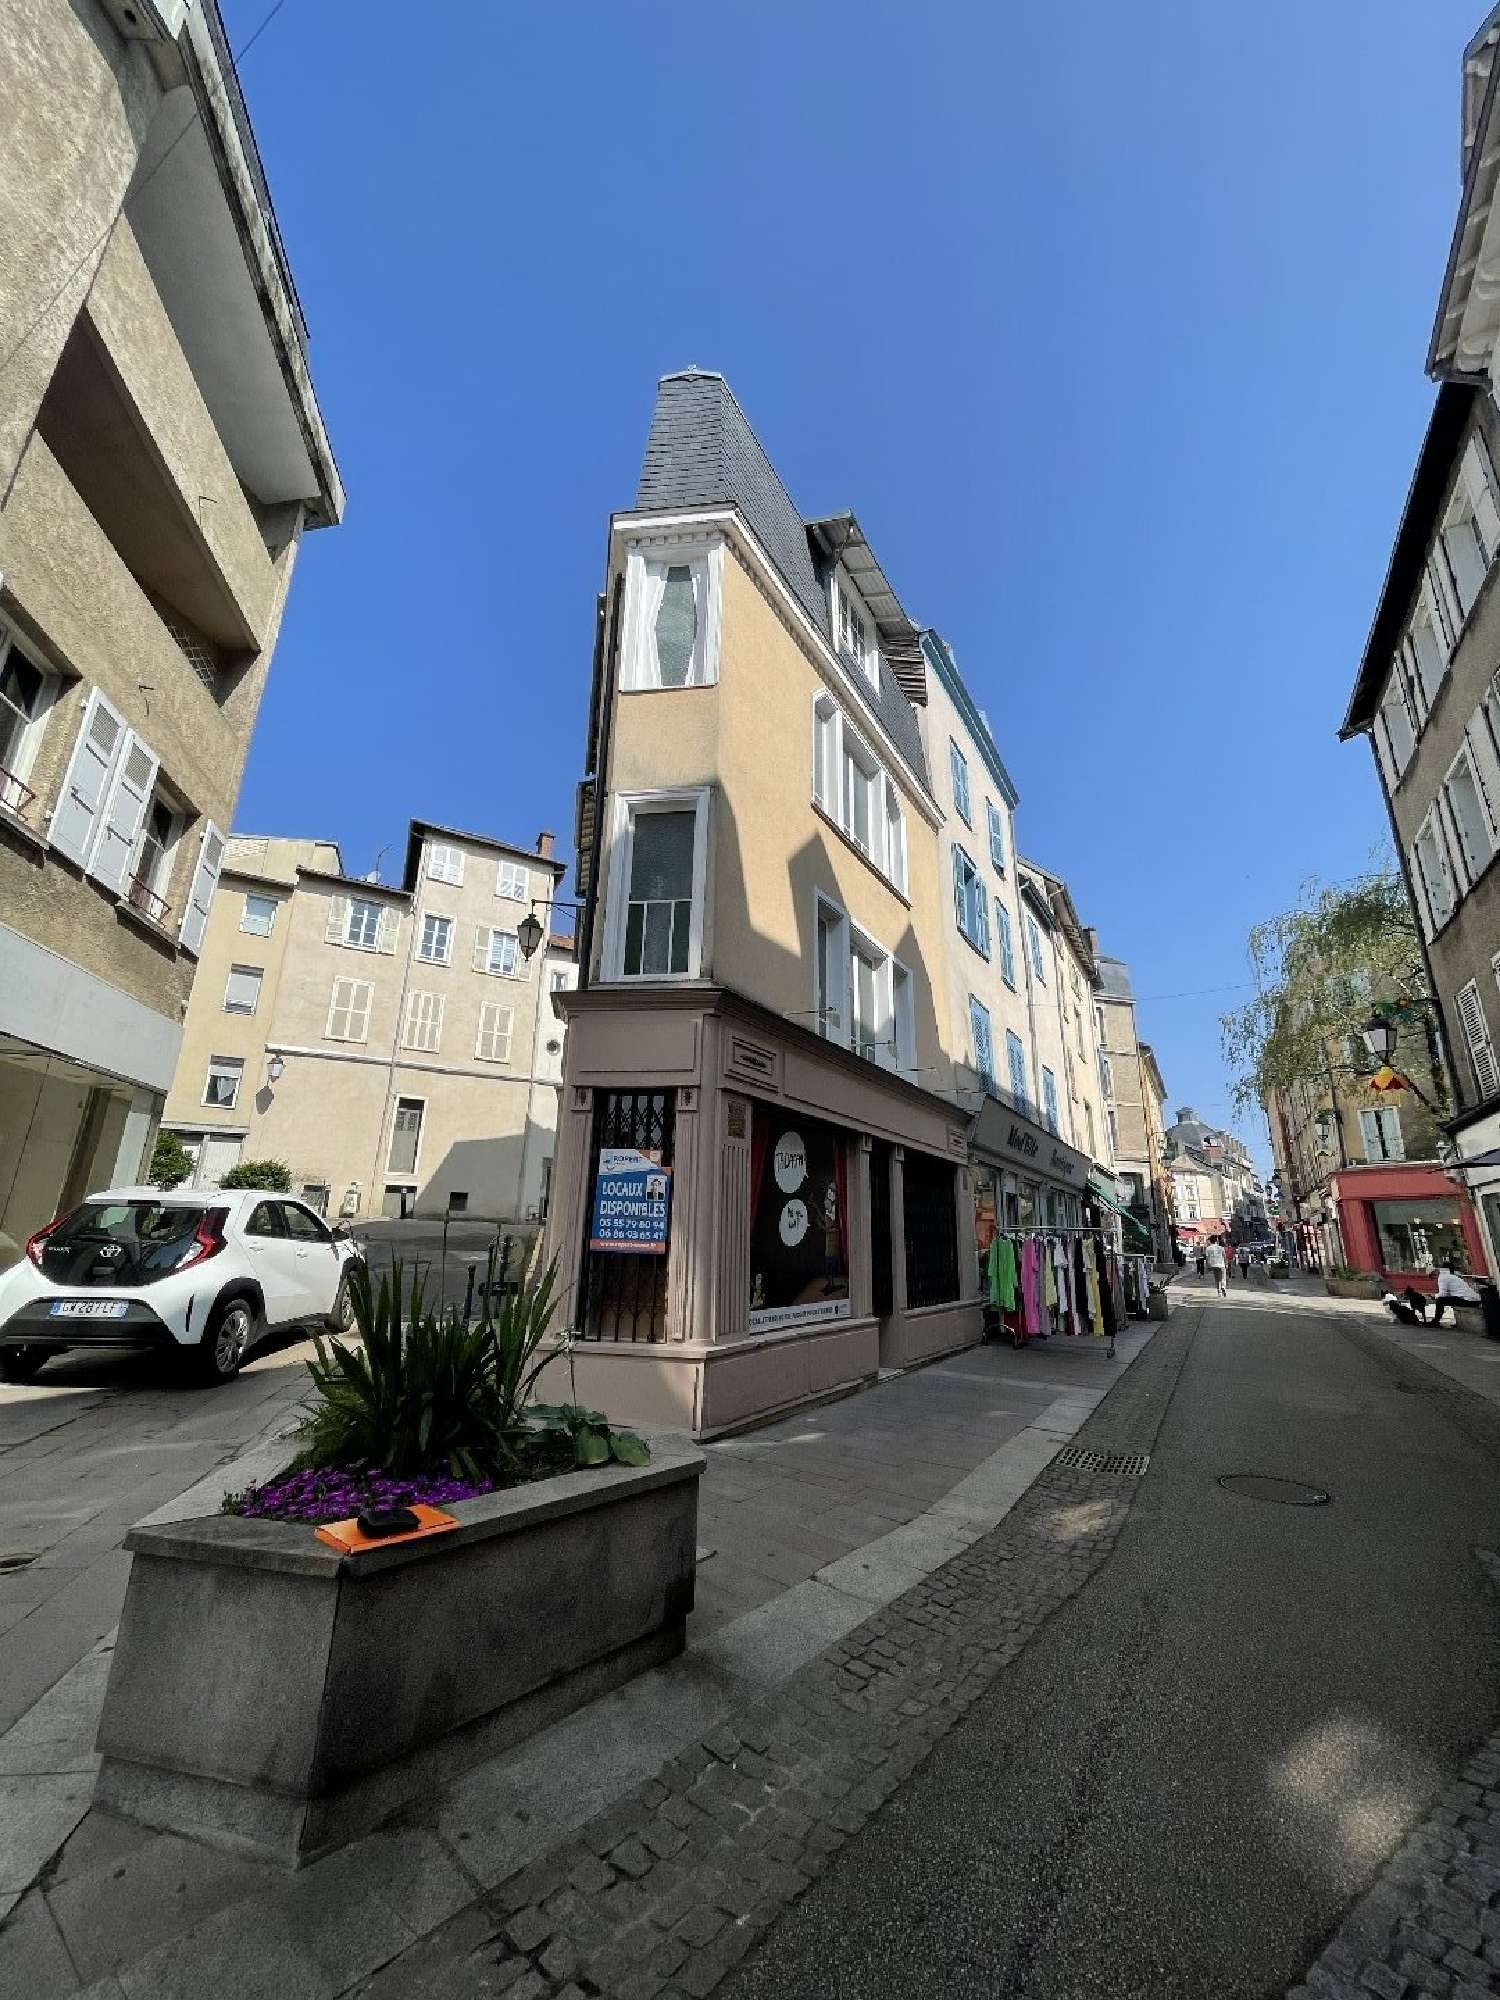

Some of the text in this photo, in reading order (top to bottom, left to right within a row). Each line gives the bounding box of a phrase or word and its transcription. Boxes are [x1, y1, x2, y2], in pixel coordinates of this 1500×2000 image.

[602, 1181, 643, 1197] LOCAUX
[600, 1200, 666, 1218] DISPONIBLES
[599, 1228, 611, 1238] 06
